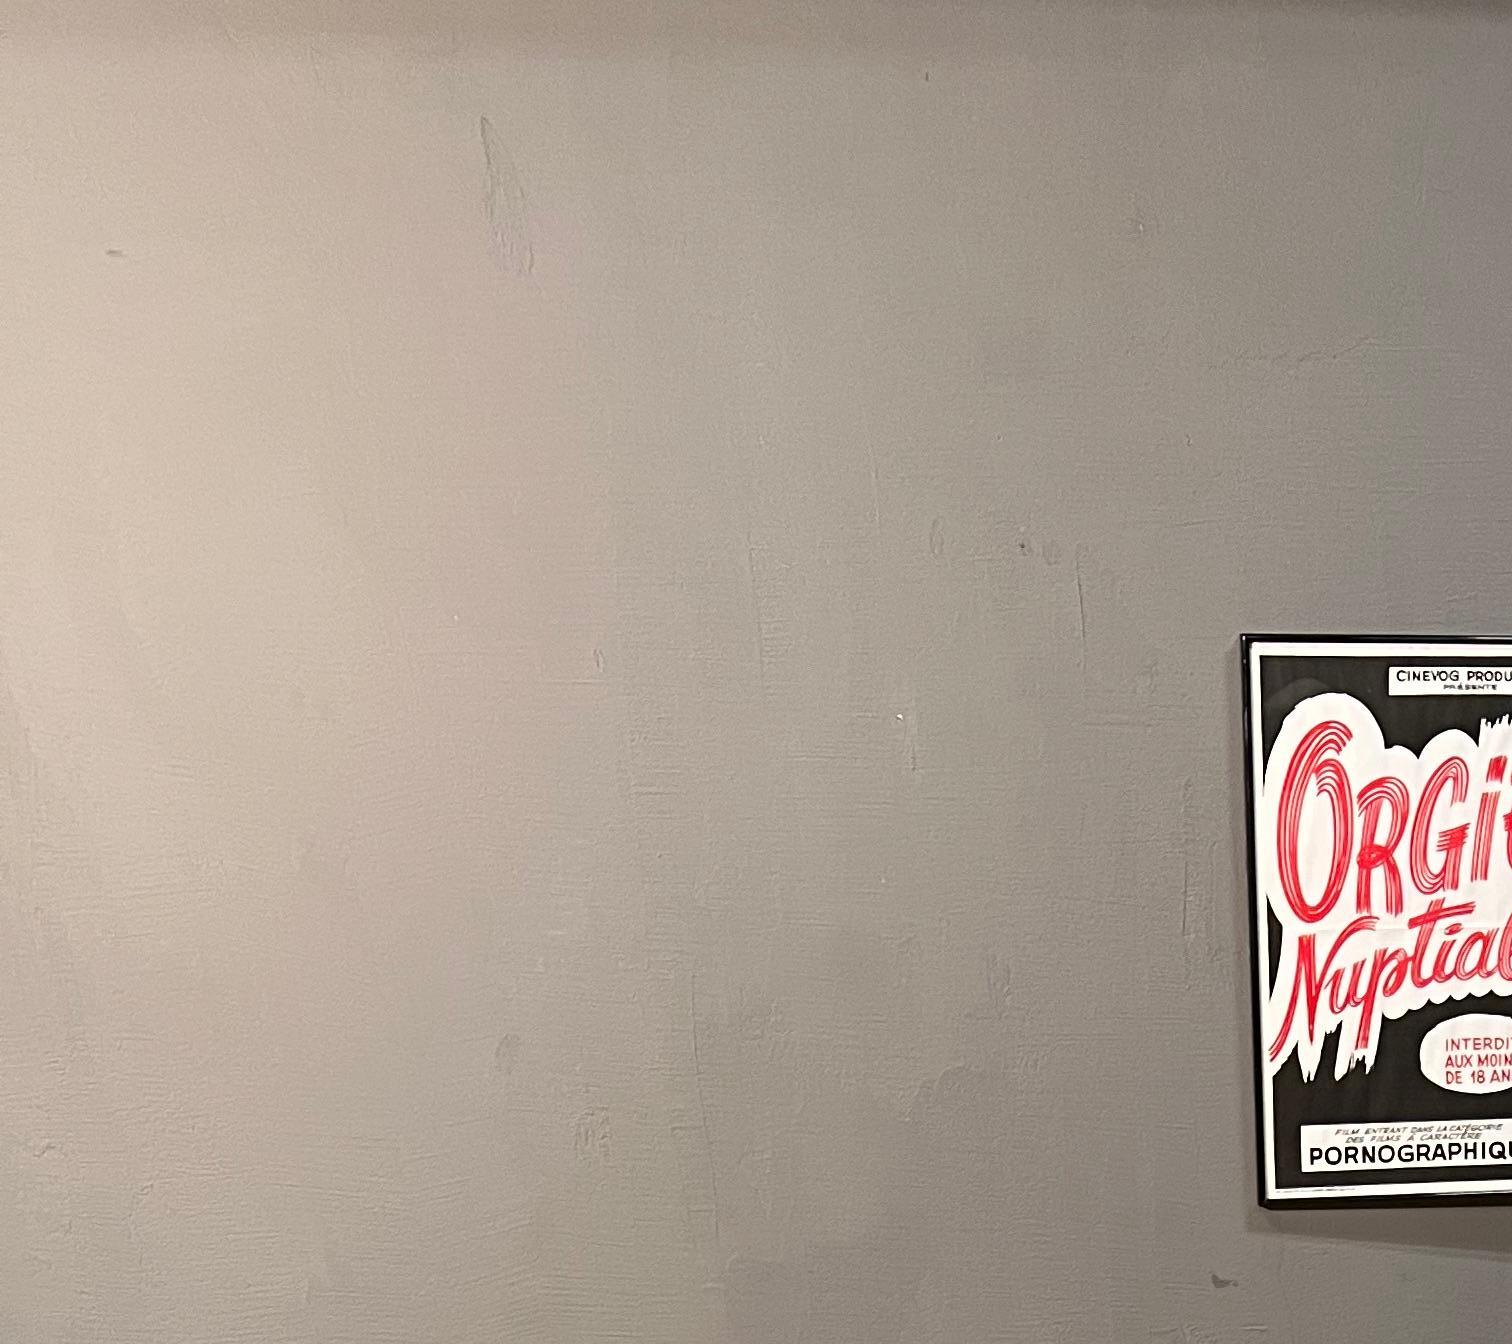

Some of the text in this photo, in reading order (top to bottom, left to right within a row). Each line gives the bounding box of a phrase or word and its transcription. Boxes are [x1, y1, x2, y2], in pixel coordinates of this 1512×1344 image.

[1396, 670, 1460, 682] CINEVOG
[1445, 1054, 1473, 1068] AUX
[1446, 1071, 1463, 1084] DE
[1471, 1070, 1485, 1084] 18
